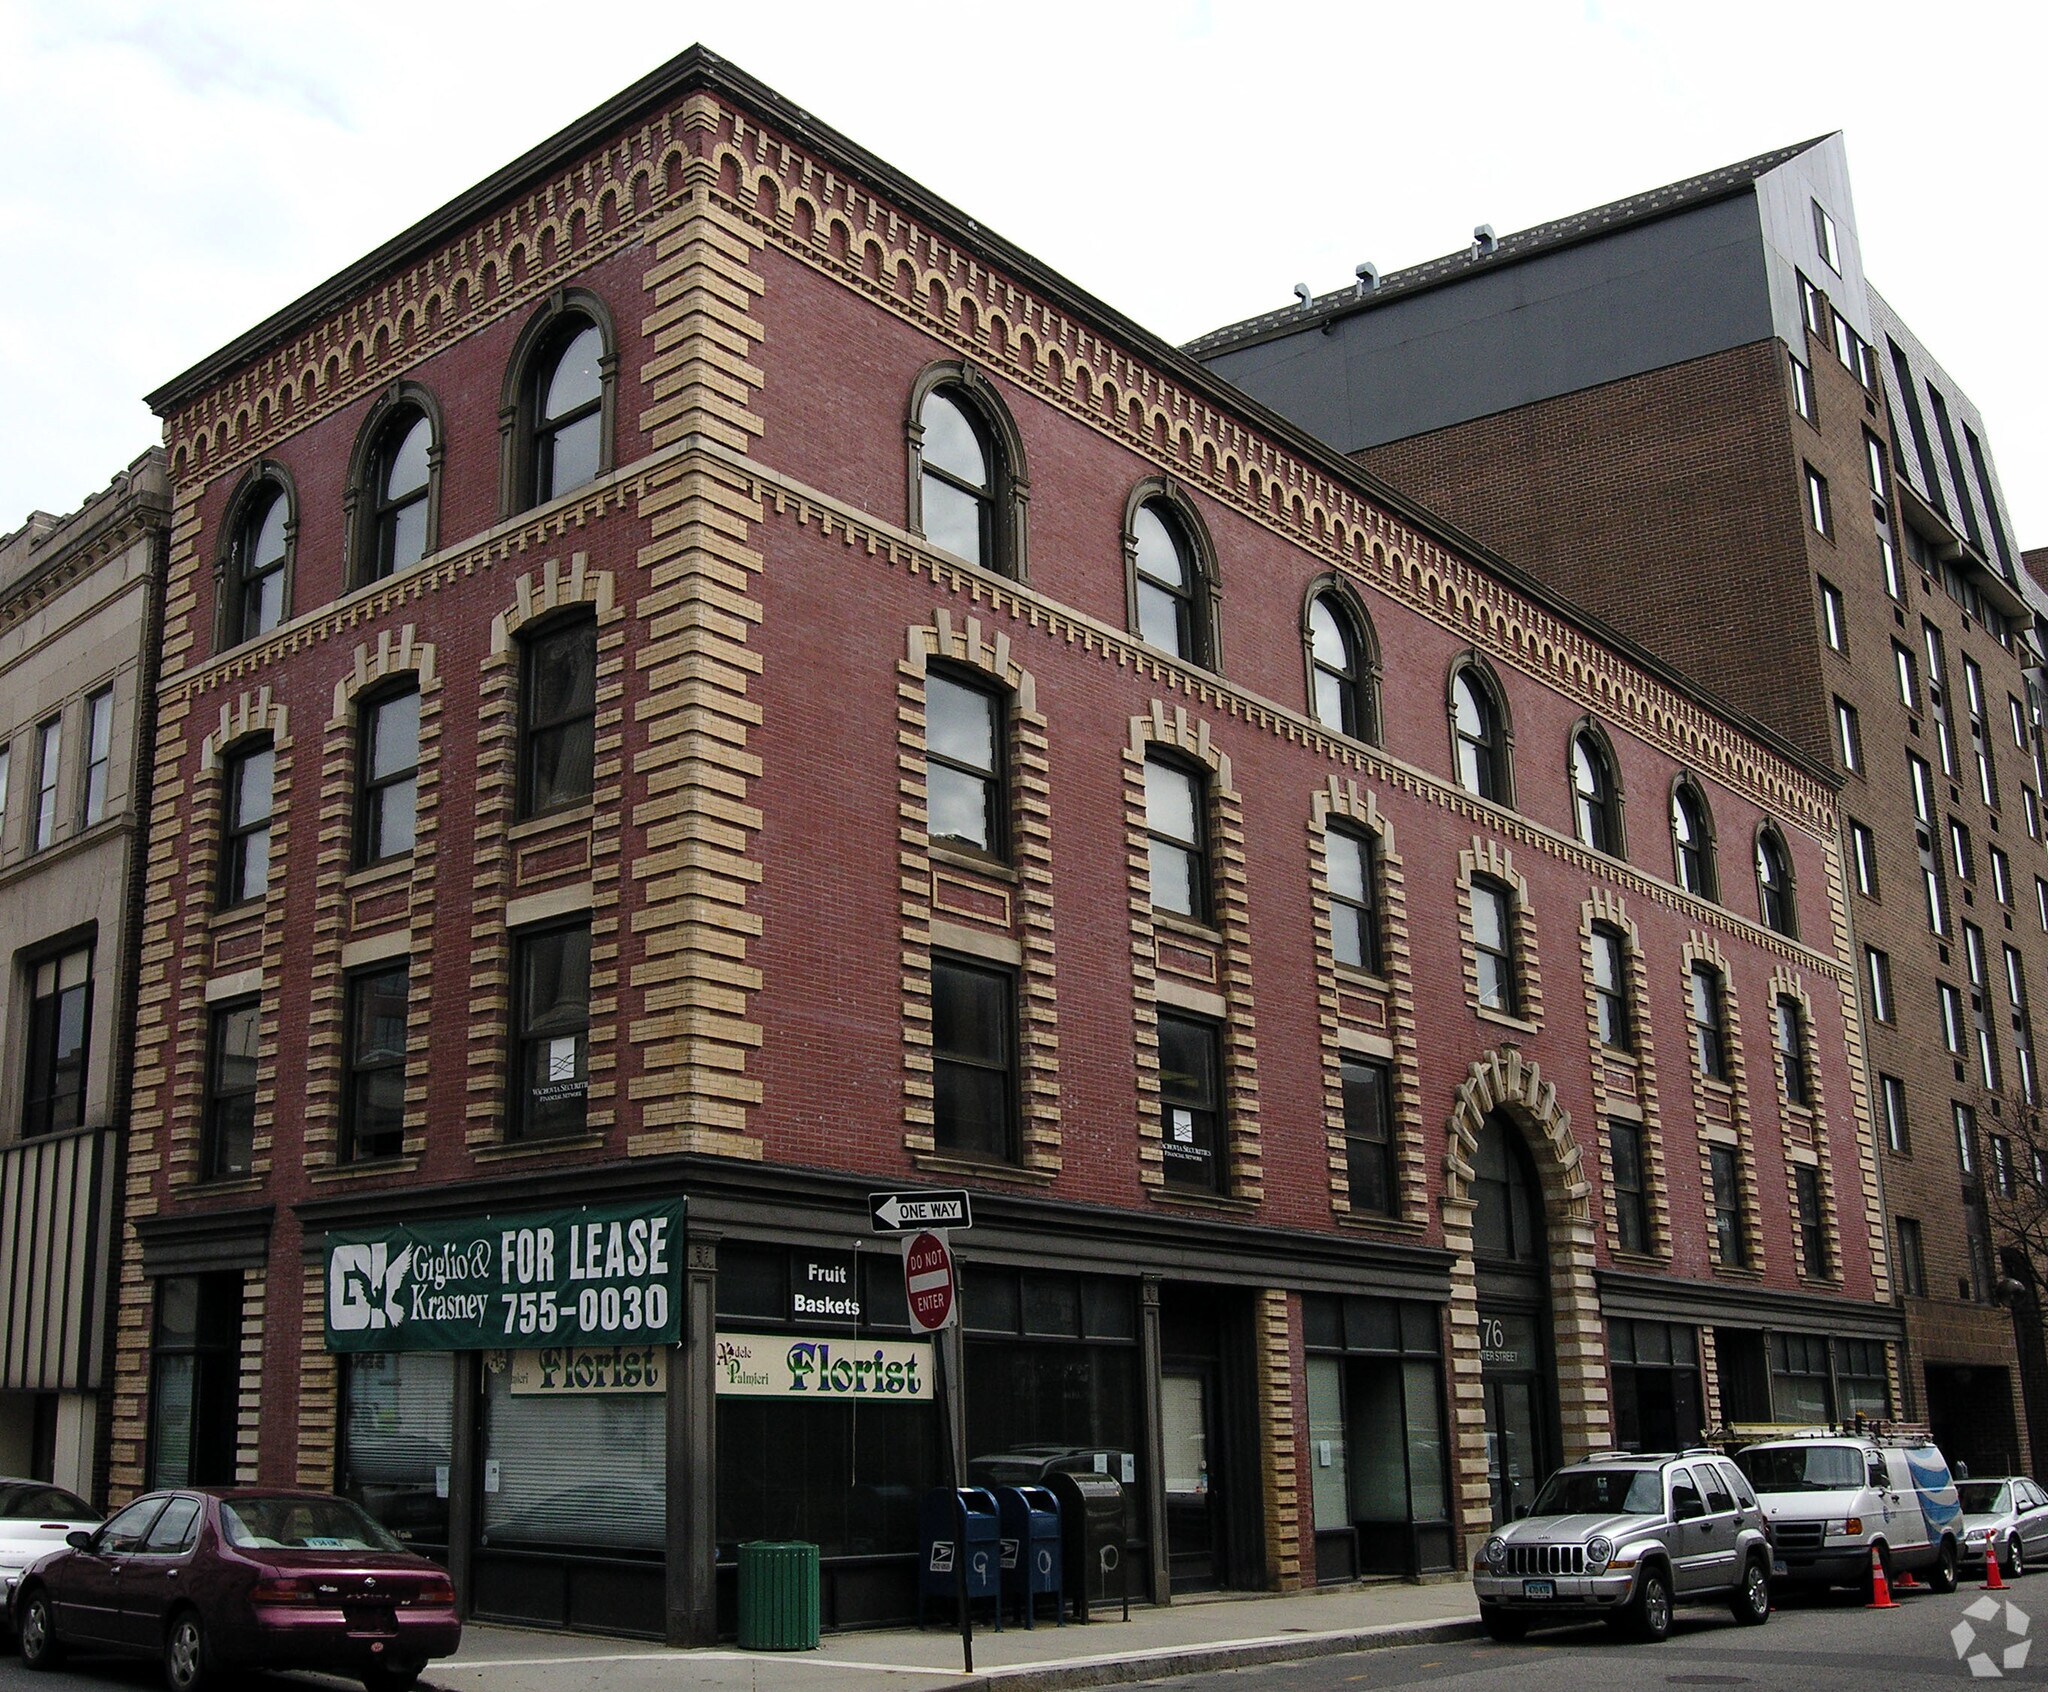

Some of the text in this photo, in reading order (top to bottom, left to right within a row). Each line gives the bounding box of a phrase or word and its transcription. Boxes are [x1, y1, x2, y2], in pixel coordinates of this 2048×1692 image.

[900, 1202, 958, 1219] ONE WAY
[412, 1238, 492, 1290] Giglio &
[501, 1217, 669, 1284] FOR LEASE
[910, 1249, 943, 1271] DO NOT
[808, 1263, 847, 1284] Fruit
[410, 1283, 489, 1328] Krasney
[501, 1283, 669, 1334] 755-0030
[794, 1293, 860, 1316] Baskets
[917, 1293, 945, 1312] ENTER
[1481, 1318, 1504, 1348] 76
[540, 1346, 659, 1389] Florist
[716, 1341, 752, 1366] Adele
[786, 1341, 922, 1394] Florist
[1495, 1351, 1518, 1362] STREET
[727, 1358, 769, 1386] Palmieri
